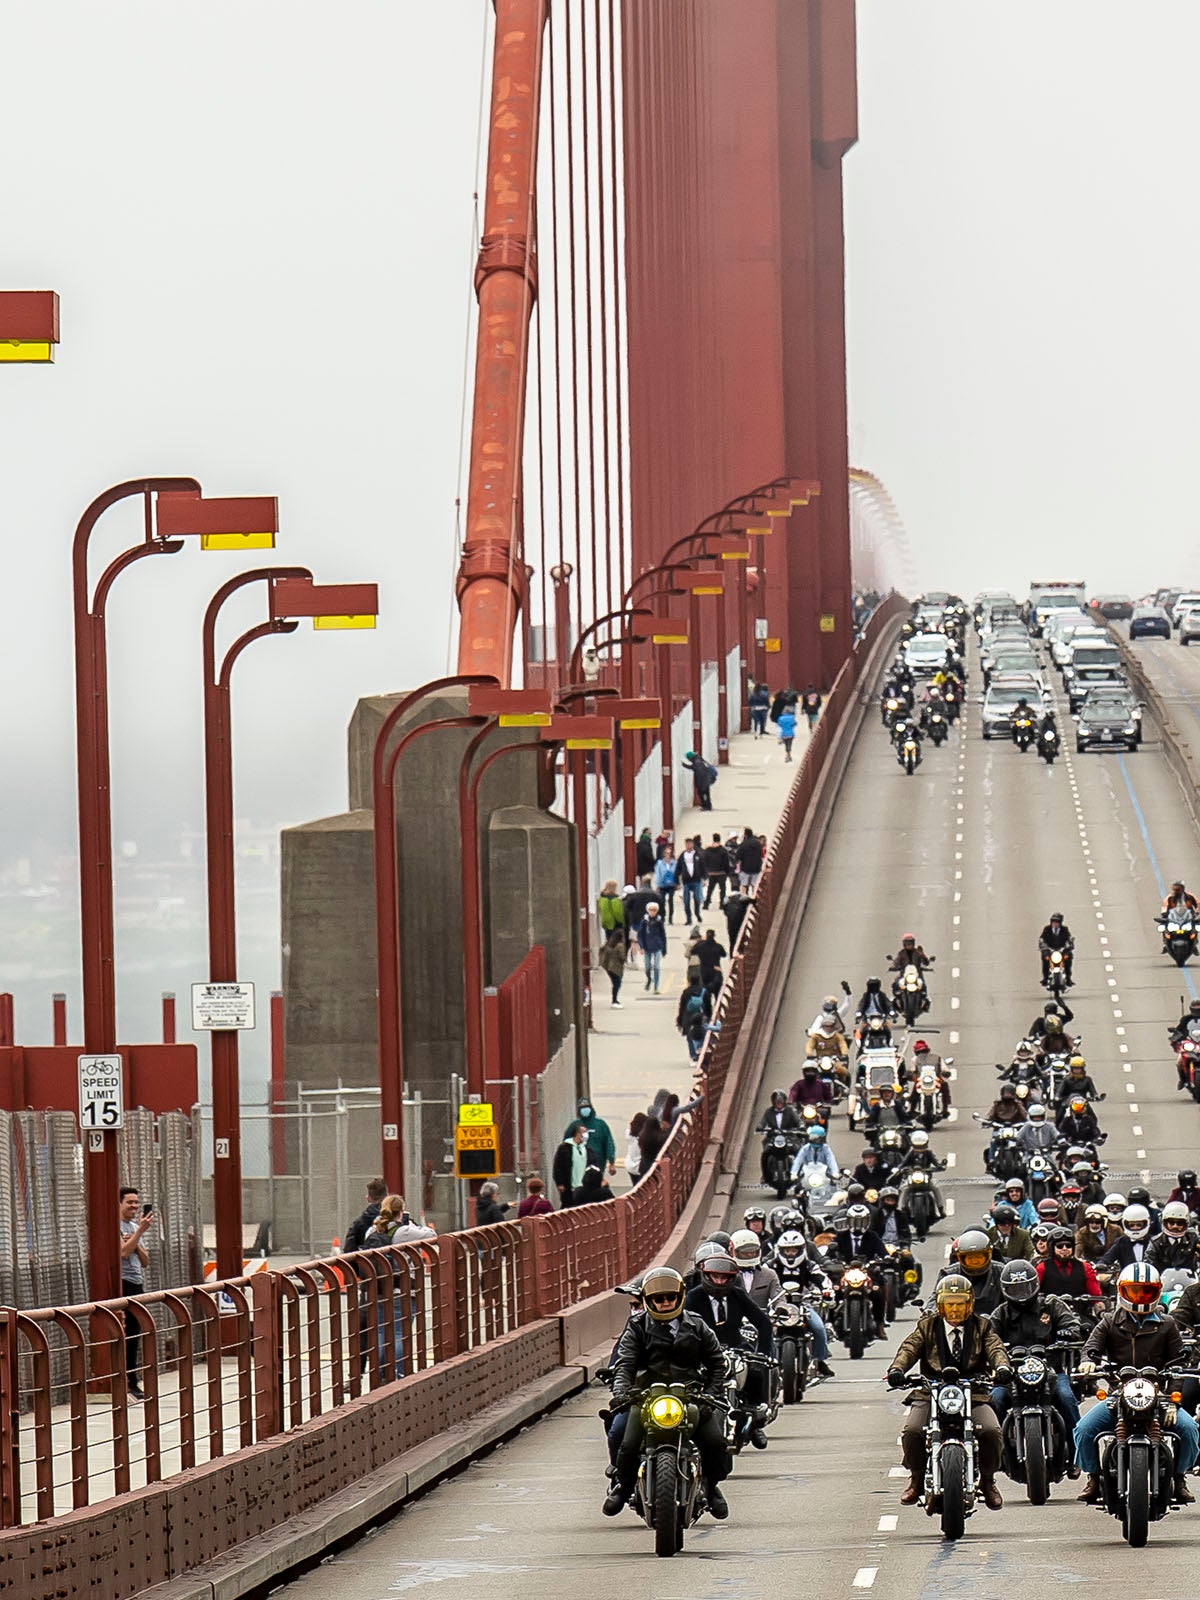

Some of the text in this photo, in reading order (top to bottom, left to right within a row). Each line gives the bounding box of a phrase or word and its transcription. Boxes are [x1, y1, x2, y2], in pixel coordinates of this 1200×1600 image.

[83, 1077, 119, 1088] SPEED
[87, 1090, 115, 1099] LIMIT
[83, 1101, 119, 1125] 15
[385, 1128, 396, 1137] 23
[462, 1128, 492, 1137] YOUR
[89, 1134, 102, 1147] 19
[460, 1139, 493, 1148] SPEED
[216, 1143, 228, 1154] 21
